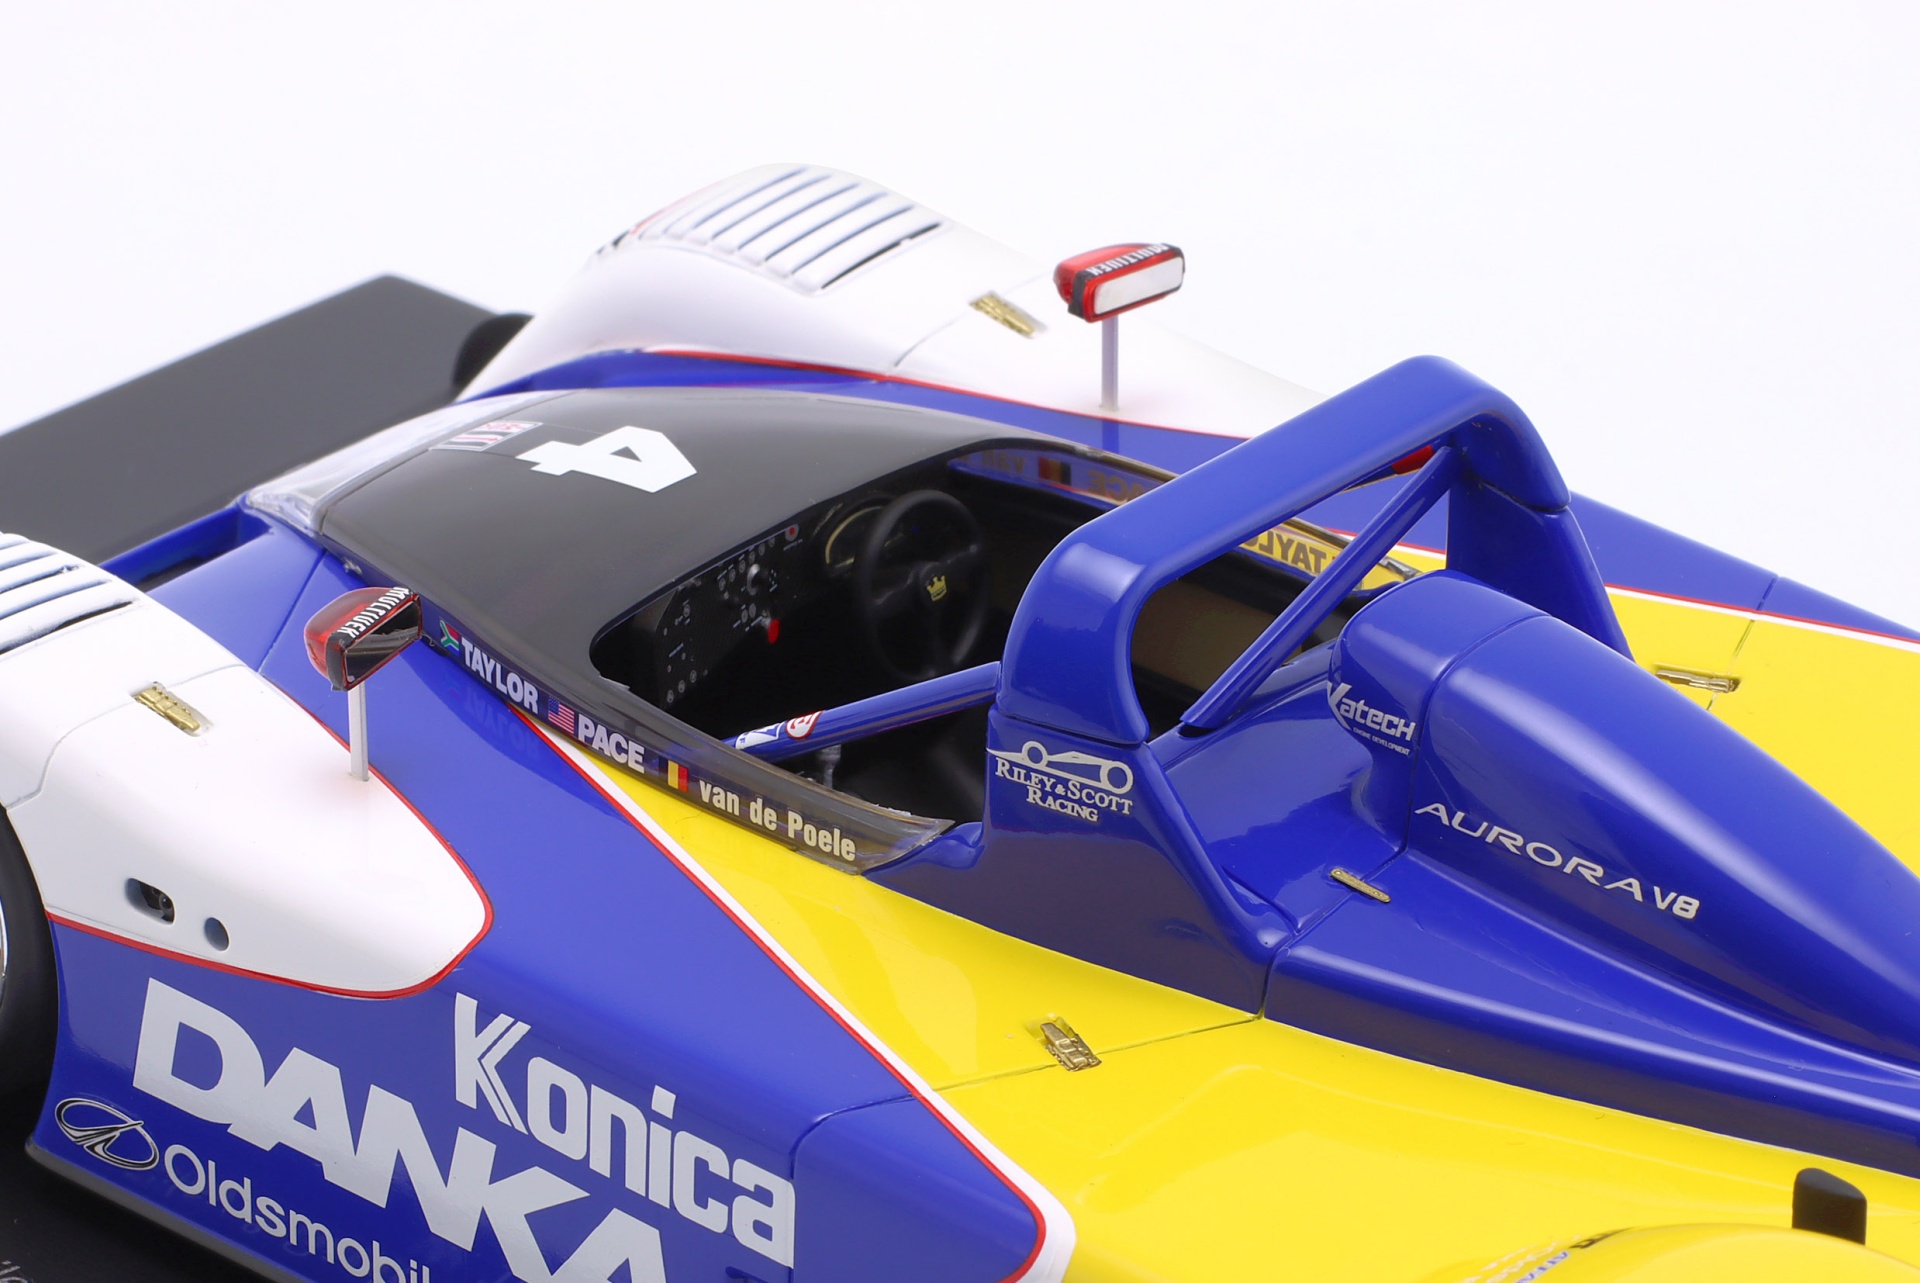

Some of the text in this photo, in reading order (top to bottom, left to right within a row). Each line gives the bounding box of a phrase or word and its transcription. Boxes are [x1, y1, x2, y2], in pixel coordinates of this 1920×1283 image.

[515, 425, 698, 494] 4
[461, 636, 539, 714] TAYLOR
[578, 713, 645, 774] PACE
[699, 780, 856, 862] van de Poele
[1026, 785, 1099, 822] RACING
[1414, 803, 1700, 919] AURORA V8
[133, 977, 667, 1283] DANKA
[454, 992, 796, 1269] Konica
